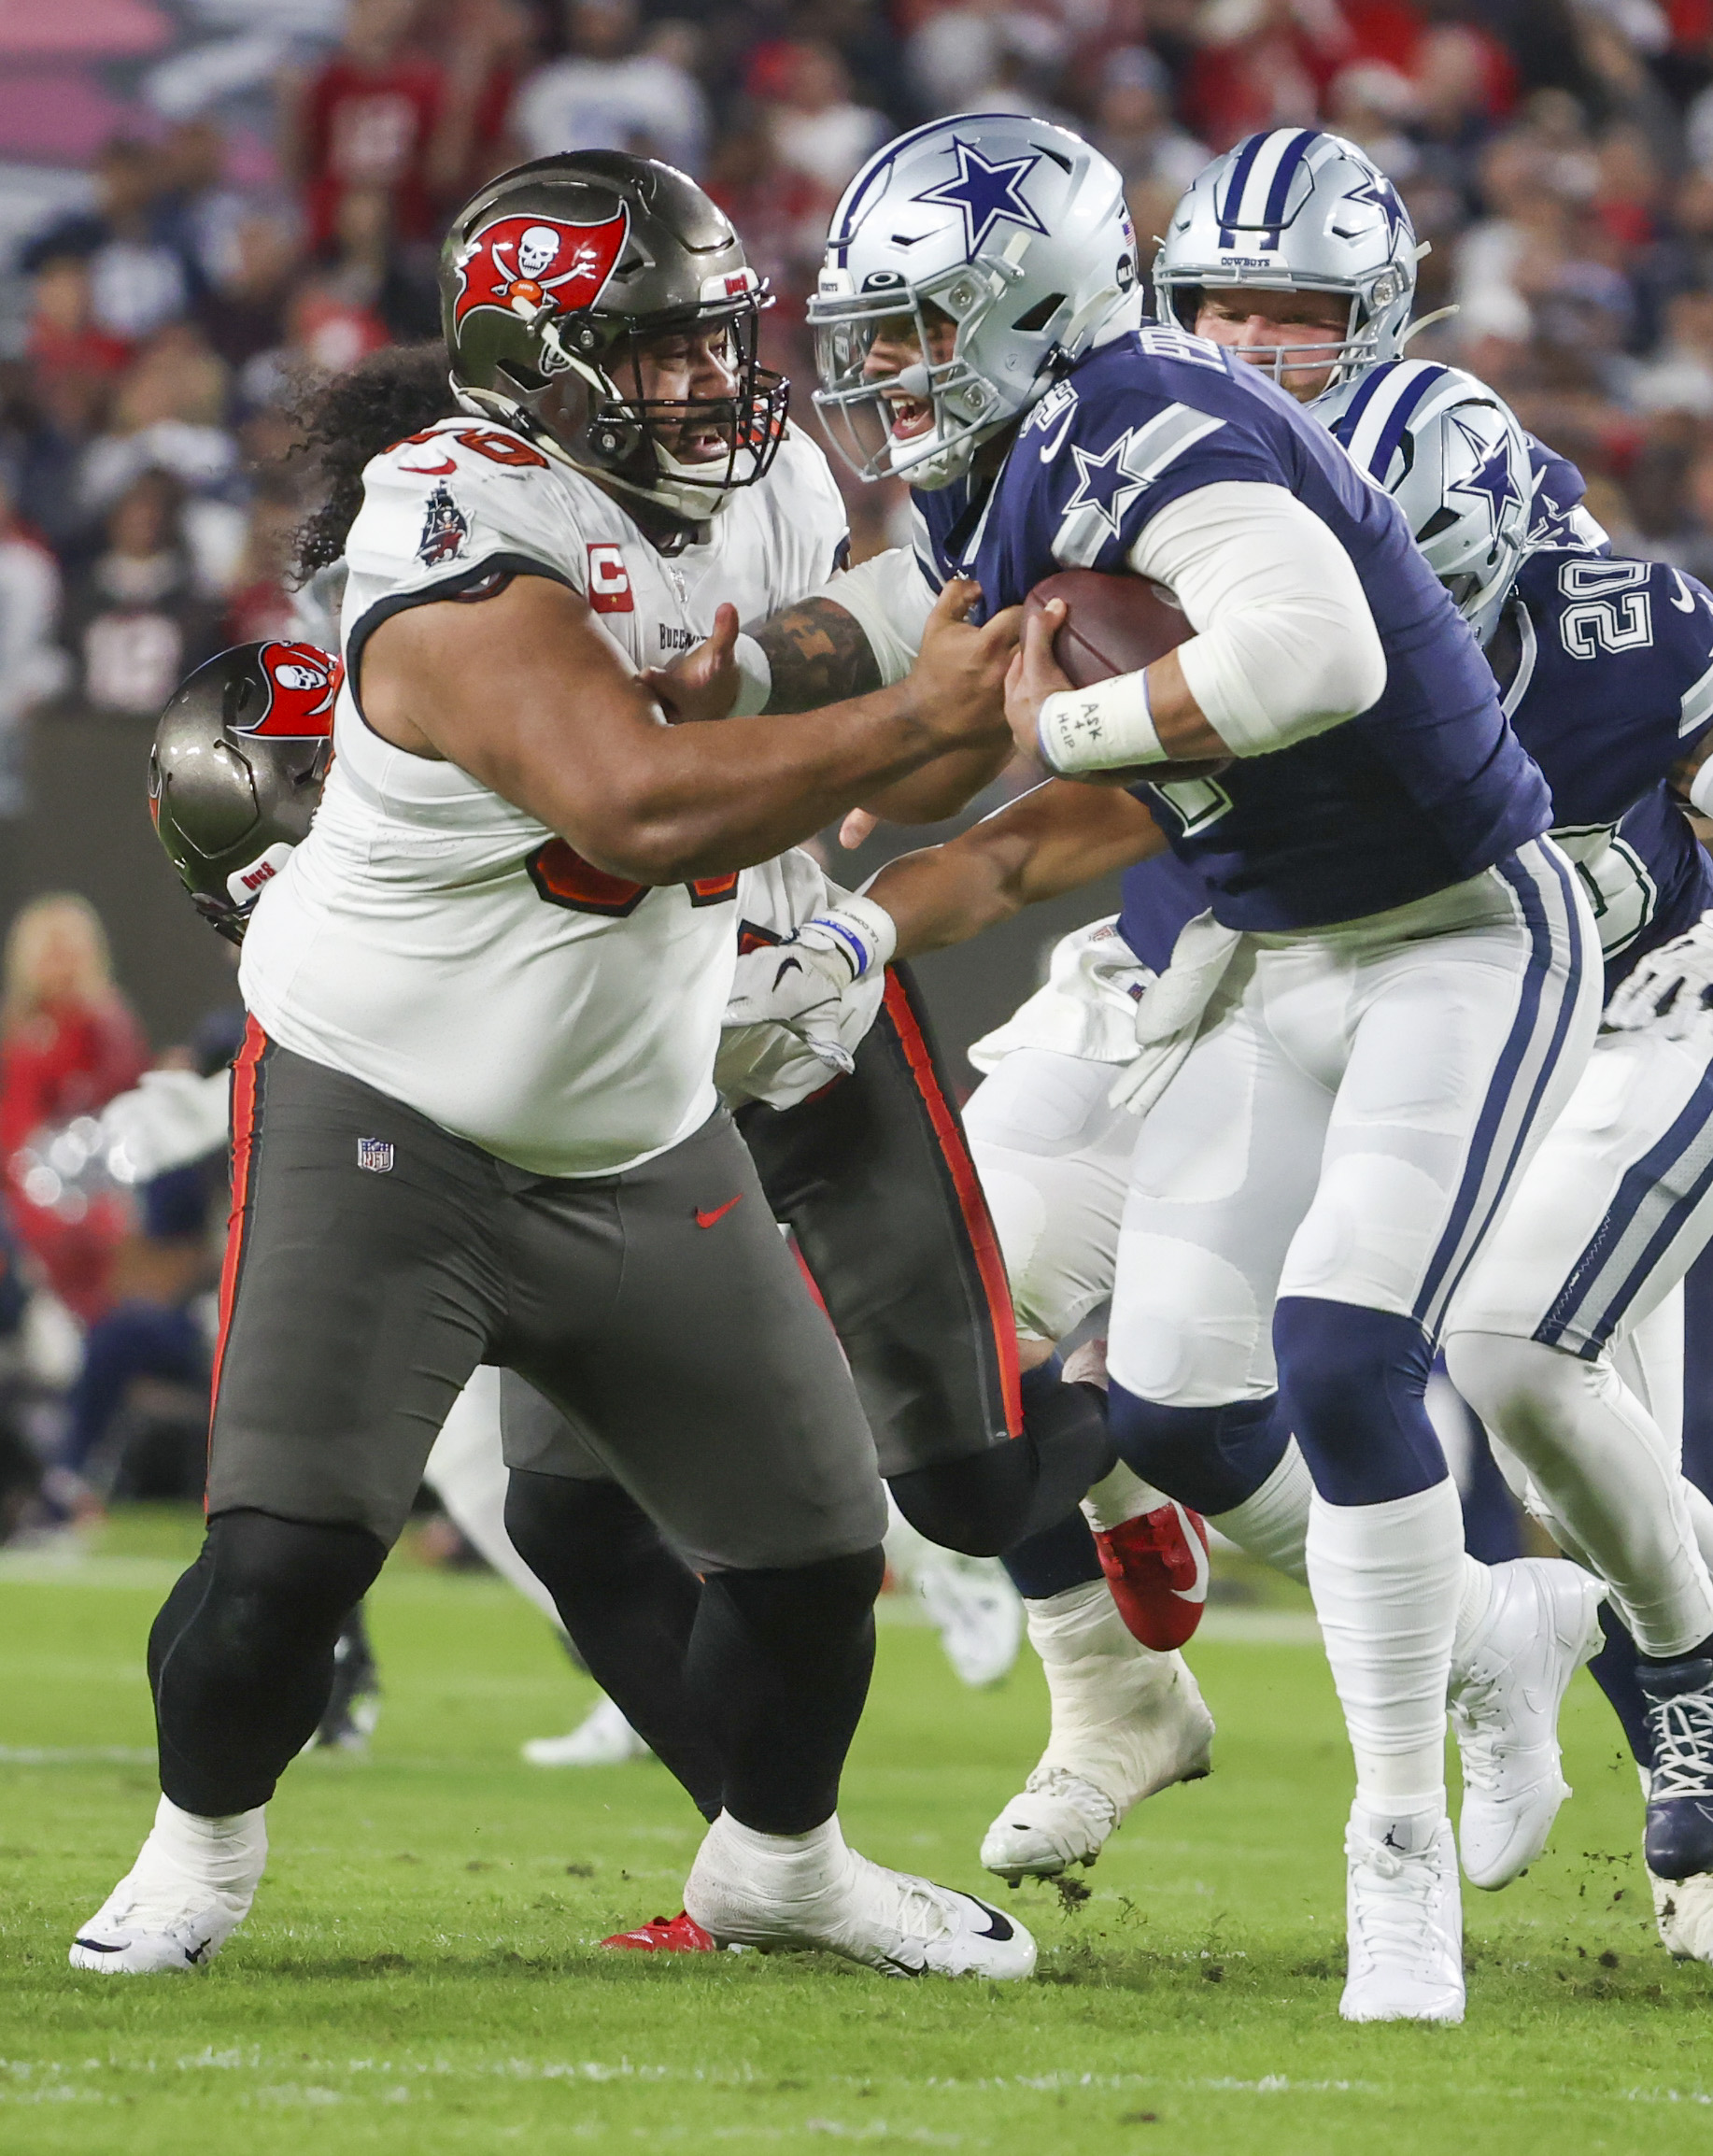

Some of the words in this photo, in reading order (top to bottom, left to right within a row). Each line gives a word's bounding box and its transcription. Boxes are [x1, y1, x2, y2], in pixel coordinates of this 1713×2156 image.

[1221, 257, 1270, 267] COWBOYS
[589, 546, 629, 594] C
[1558, 559, 1653, 660] 20
